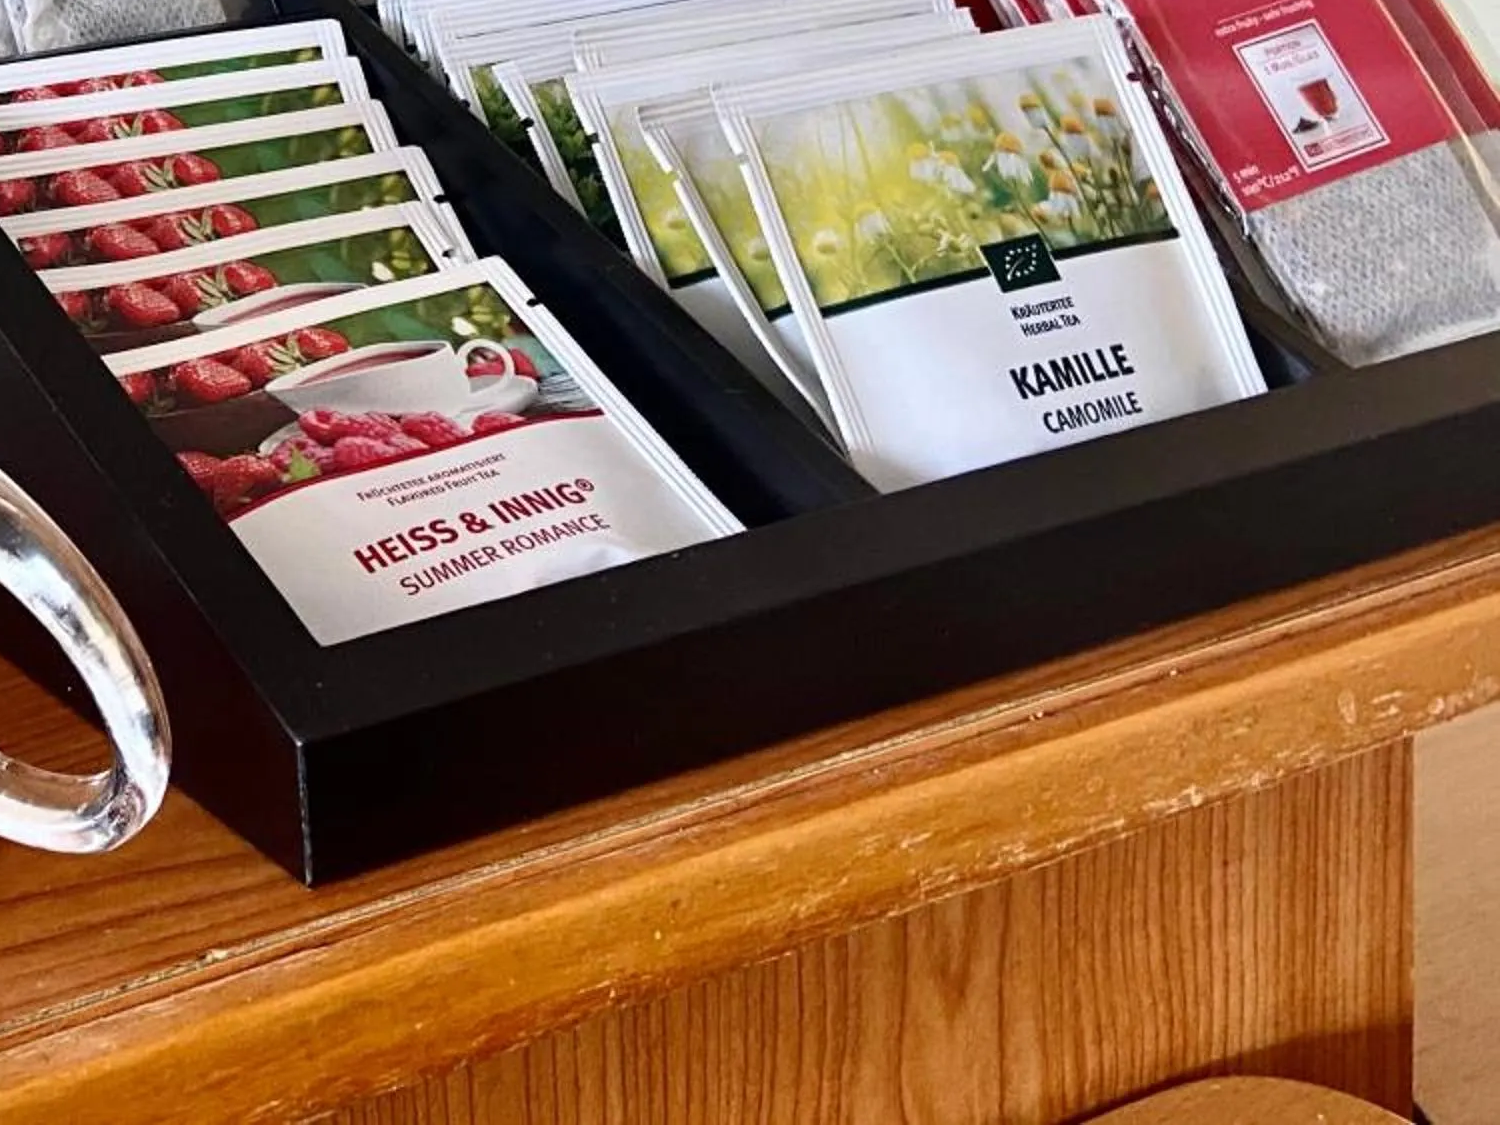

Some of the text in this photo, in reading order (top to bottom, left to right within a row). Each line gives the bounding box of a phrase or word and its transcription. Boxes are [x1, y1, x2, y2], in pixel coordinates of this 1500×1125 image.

[1010, 295, 1075, 320] KRÄUTERTEE
[1020, 312, 1081, 338] HERBAL TEA
[1009, 343, 1135, 400] KAMILLE
[1043, 391, 1143, 434] CAMOMILE
[353, 519, 460, 574] HEISS
[458, 511, 494, 536] &
[399, 513, 611, 597] SUMMER ROMANCE
